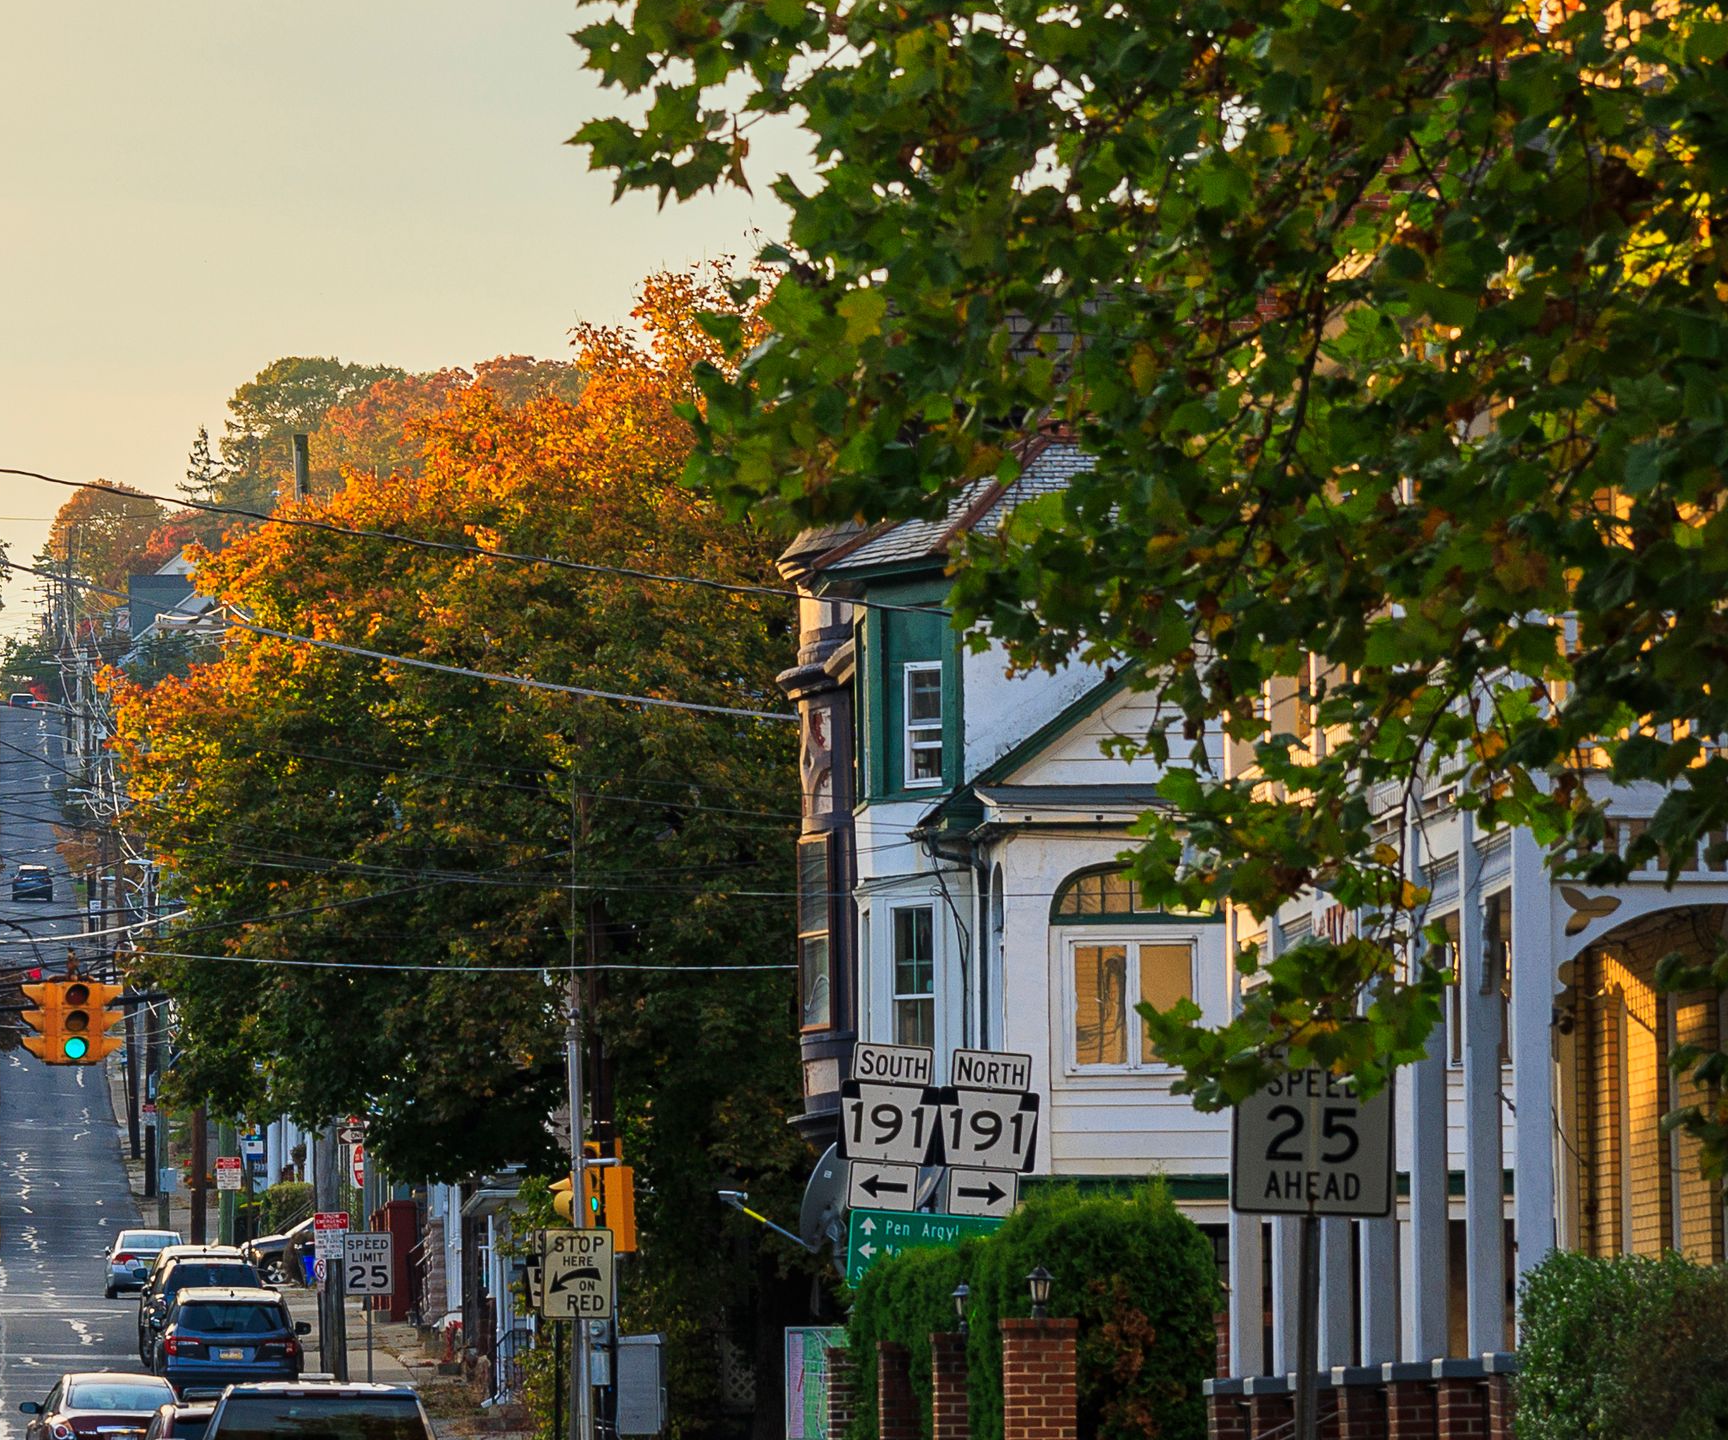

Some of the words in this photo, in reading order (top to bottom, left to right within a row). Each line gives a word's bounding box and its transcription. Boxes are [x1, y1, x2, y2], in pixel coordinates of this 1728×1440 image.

[860, 1050, 928, 1080] SOUTH
[957, 1056, 1025, 1086] NORTH
[850, 1101, 925, 1148] 191
[949, 1108, 1024, 1155] 191
[1265, 1105, 1359, 1164] 25
[1264, 1171, 1360, 1200] AHEAD
[886, 1220, 910, 1236] Pen
[922, 1223, 959, 1242] Argyl
[347, 1240, 389, 1250] SPEED
[554, 1236, 604, 1253] STOP
[351, 1253, 384, 1263] LIMIT
[563, 1256, 594, 1267] HERE
[349, 1265, 389, 1288] 25
[579, 1280, 595, 1291] ON
[567, 1294, 604, 1311] RED
